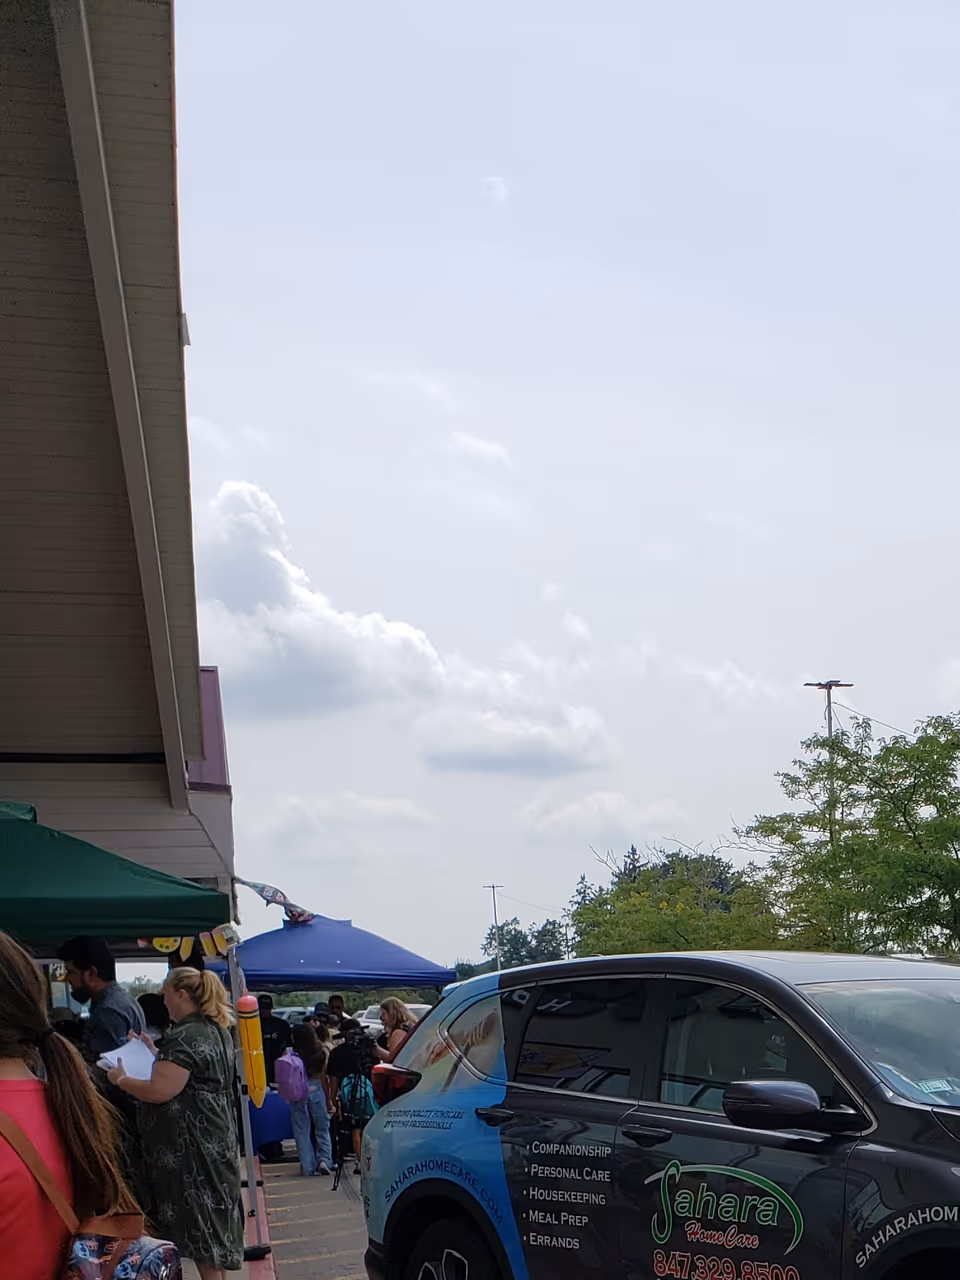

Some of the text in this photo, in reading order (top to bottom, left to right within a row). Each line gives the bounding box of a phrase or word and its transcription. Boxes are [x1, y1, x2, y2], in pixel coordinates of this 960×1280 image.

[531, 1141, 612, 1158] COMPANIONSHIP
[530, 1163, 611, 1182] PERSONAL CARE
[384, 1159, 504, 1225] SAHARAHOMECARE.COM
[529, 1186, 606, 1205] HOUSEKEEPING
[651, 1160, 780, 1244] Sahara
[529, 1209, 589, 1227] MEAL PREP
[529, 1232, 580, 1249] ERRANDS
